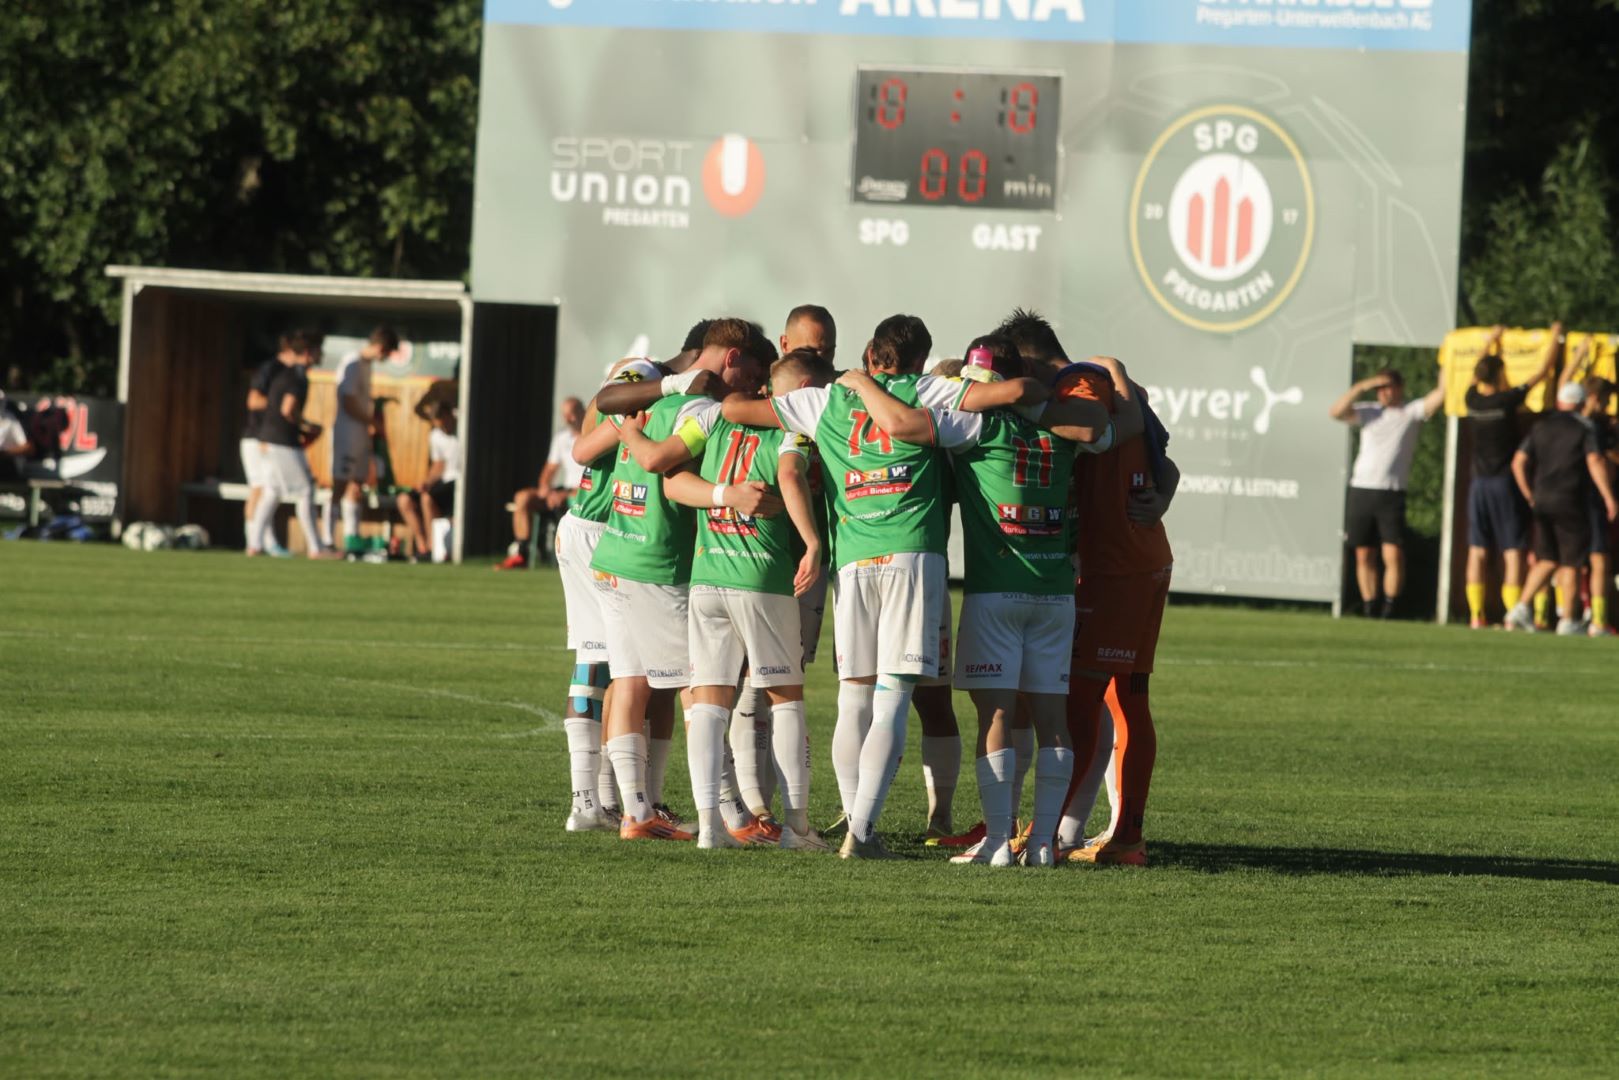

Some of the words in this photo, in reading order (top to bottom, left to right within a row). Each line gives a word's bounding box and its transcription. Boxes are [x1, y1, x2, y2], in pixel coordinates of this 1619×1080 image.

[1193, 119, 1259, 153] SPG
[551, 137, 692, 171] SPORT
[919, 148, 988, 201] 00
[1003, 174, 1051, 197] min
[603, 207, 690, 228] PREGARTEN
[1282, 208, 1298, 225] 17
[859, 219, 909, 245] SPG
[972, 223, 1042, 251] GAST
[1163, 268, 1275, 312] PREGARTEN
[848, 408, 894, 458] 14
[1010, 433, 1055, 488] 11
[965, 663, 1003, 673] RE/MAX
[1097, 647, 1137, 660] RE/MAX
